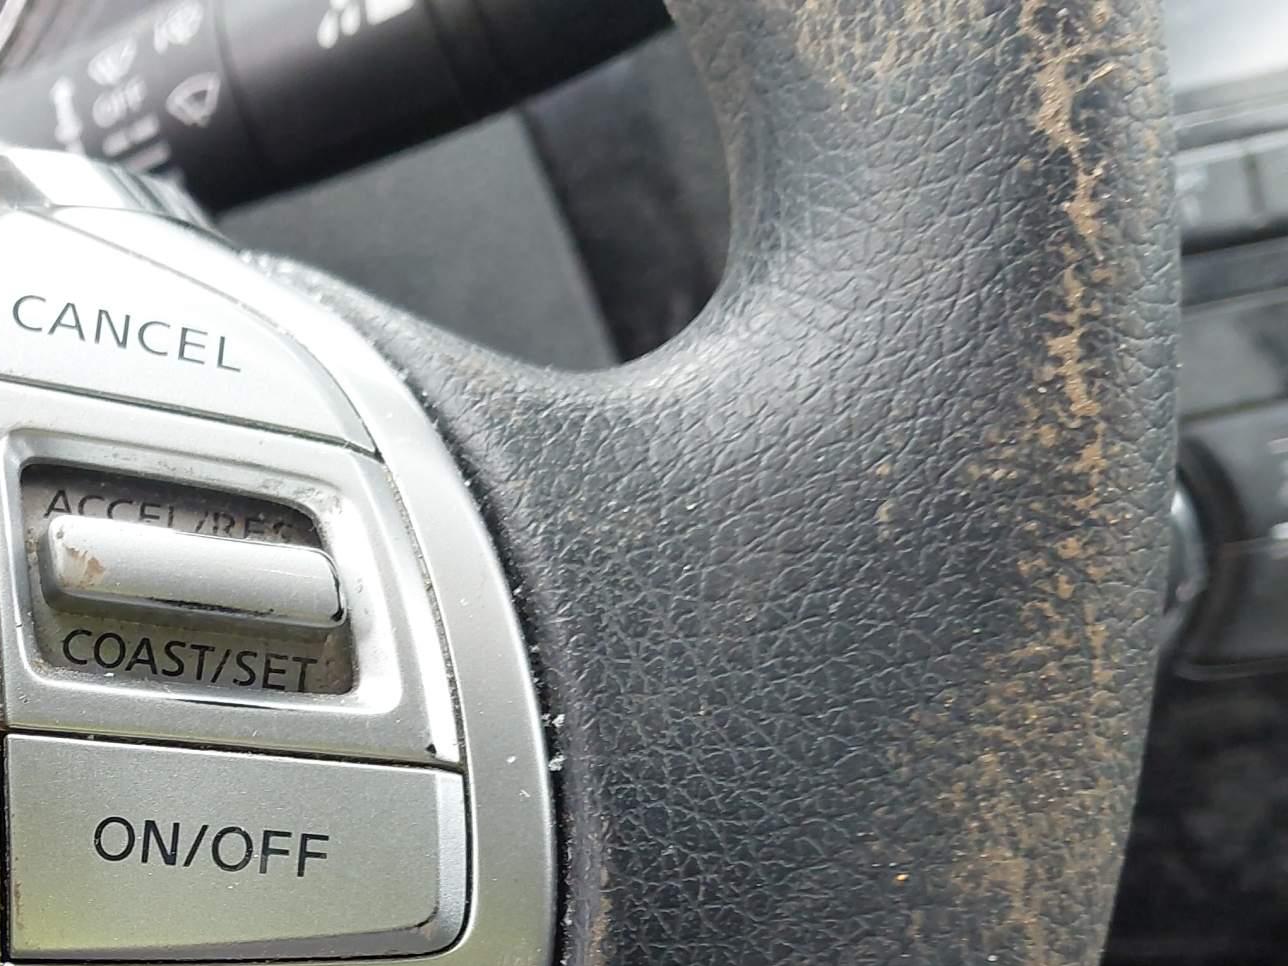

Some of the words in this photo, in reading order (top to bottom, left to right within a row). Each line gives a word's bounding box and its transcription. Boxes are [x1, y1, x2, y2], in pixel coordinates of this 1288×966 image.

[11, 294, 242, 374] CANCEL
[62, 628, 318, 693] COAST/SET
[93, 815, 330, 878] ON/OFF
